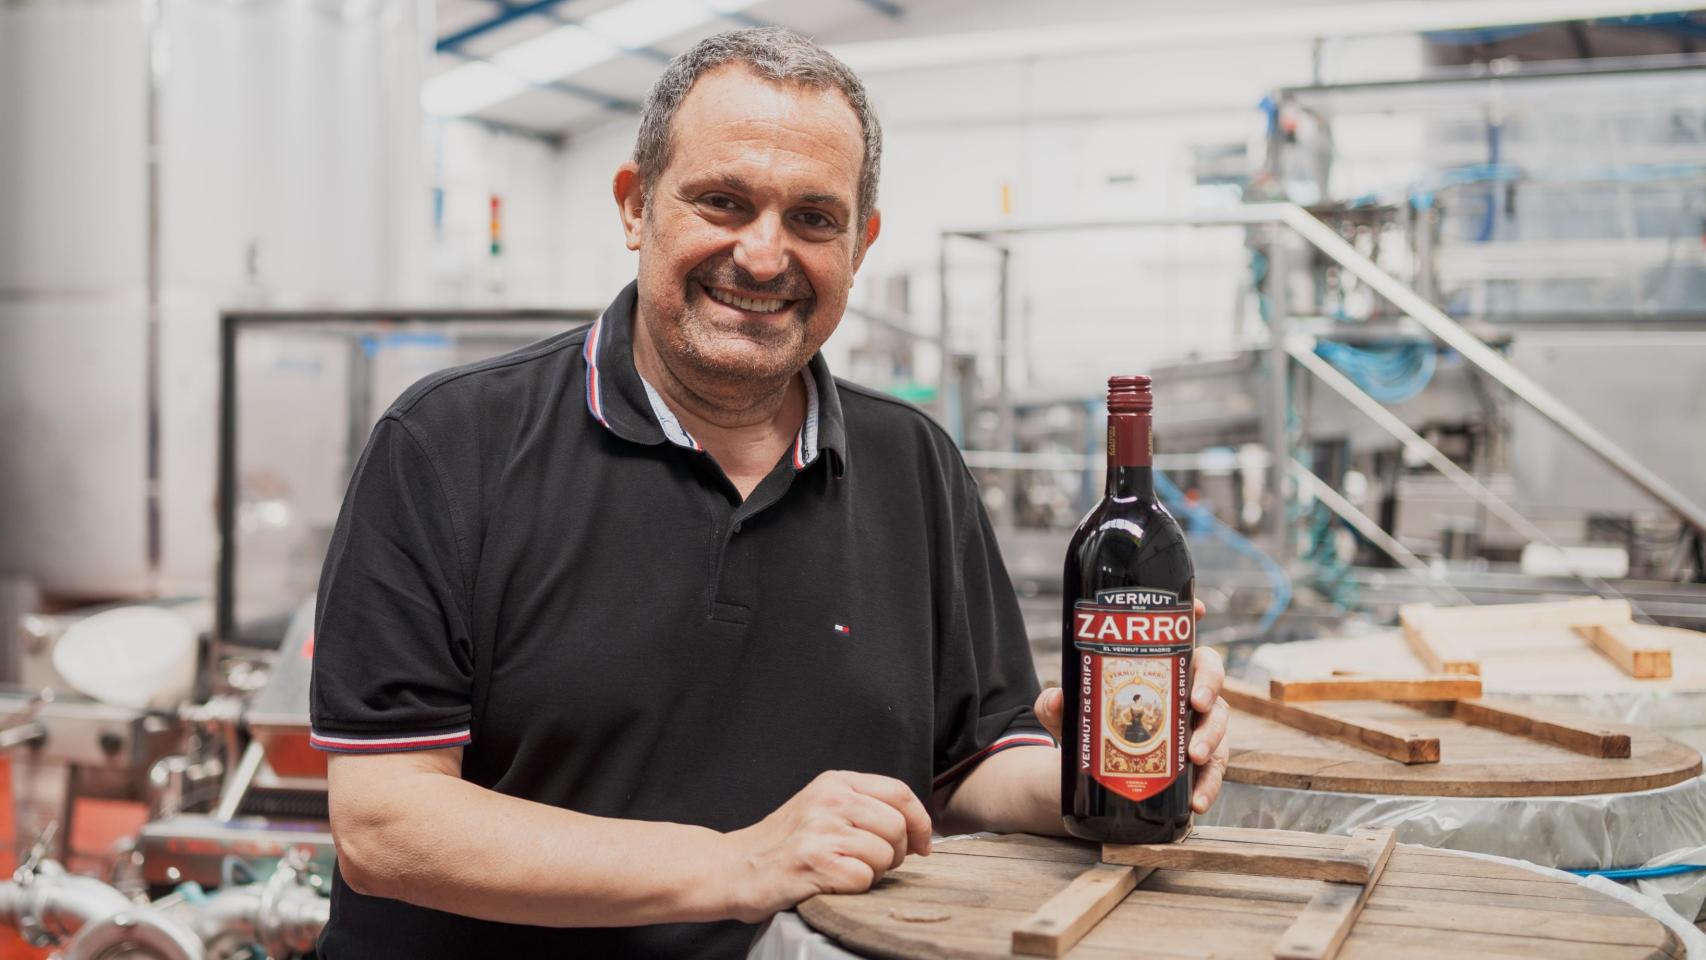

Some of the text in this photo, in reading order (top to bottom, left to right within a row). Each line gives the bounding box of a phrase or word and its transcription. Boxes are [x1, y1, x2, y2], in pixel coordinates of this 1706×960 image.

[1104, 592, 1171, 605] VERMUT
[1078, 613, 1191, 640] ZARRO
[1082, 655, 1092, 769] VERMUT DE GRIFO
[1179, 700, 1186, 715] DE
